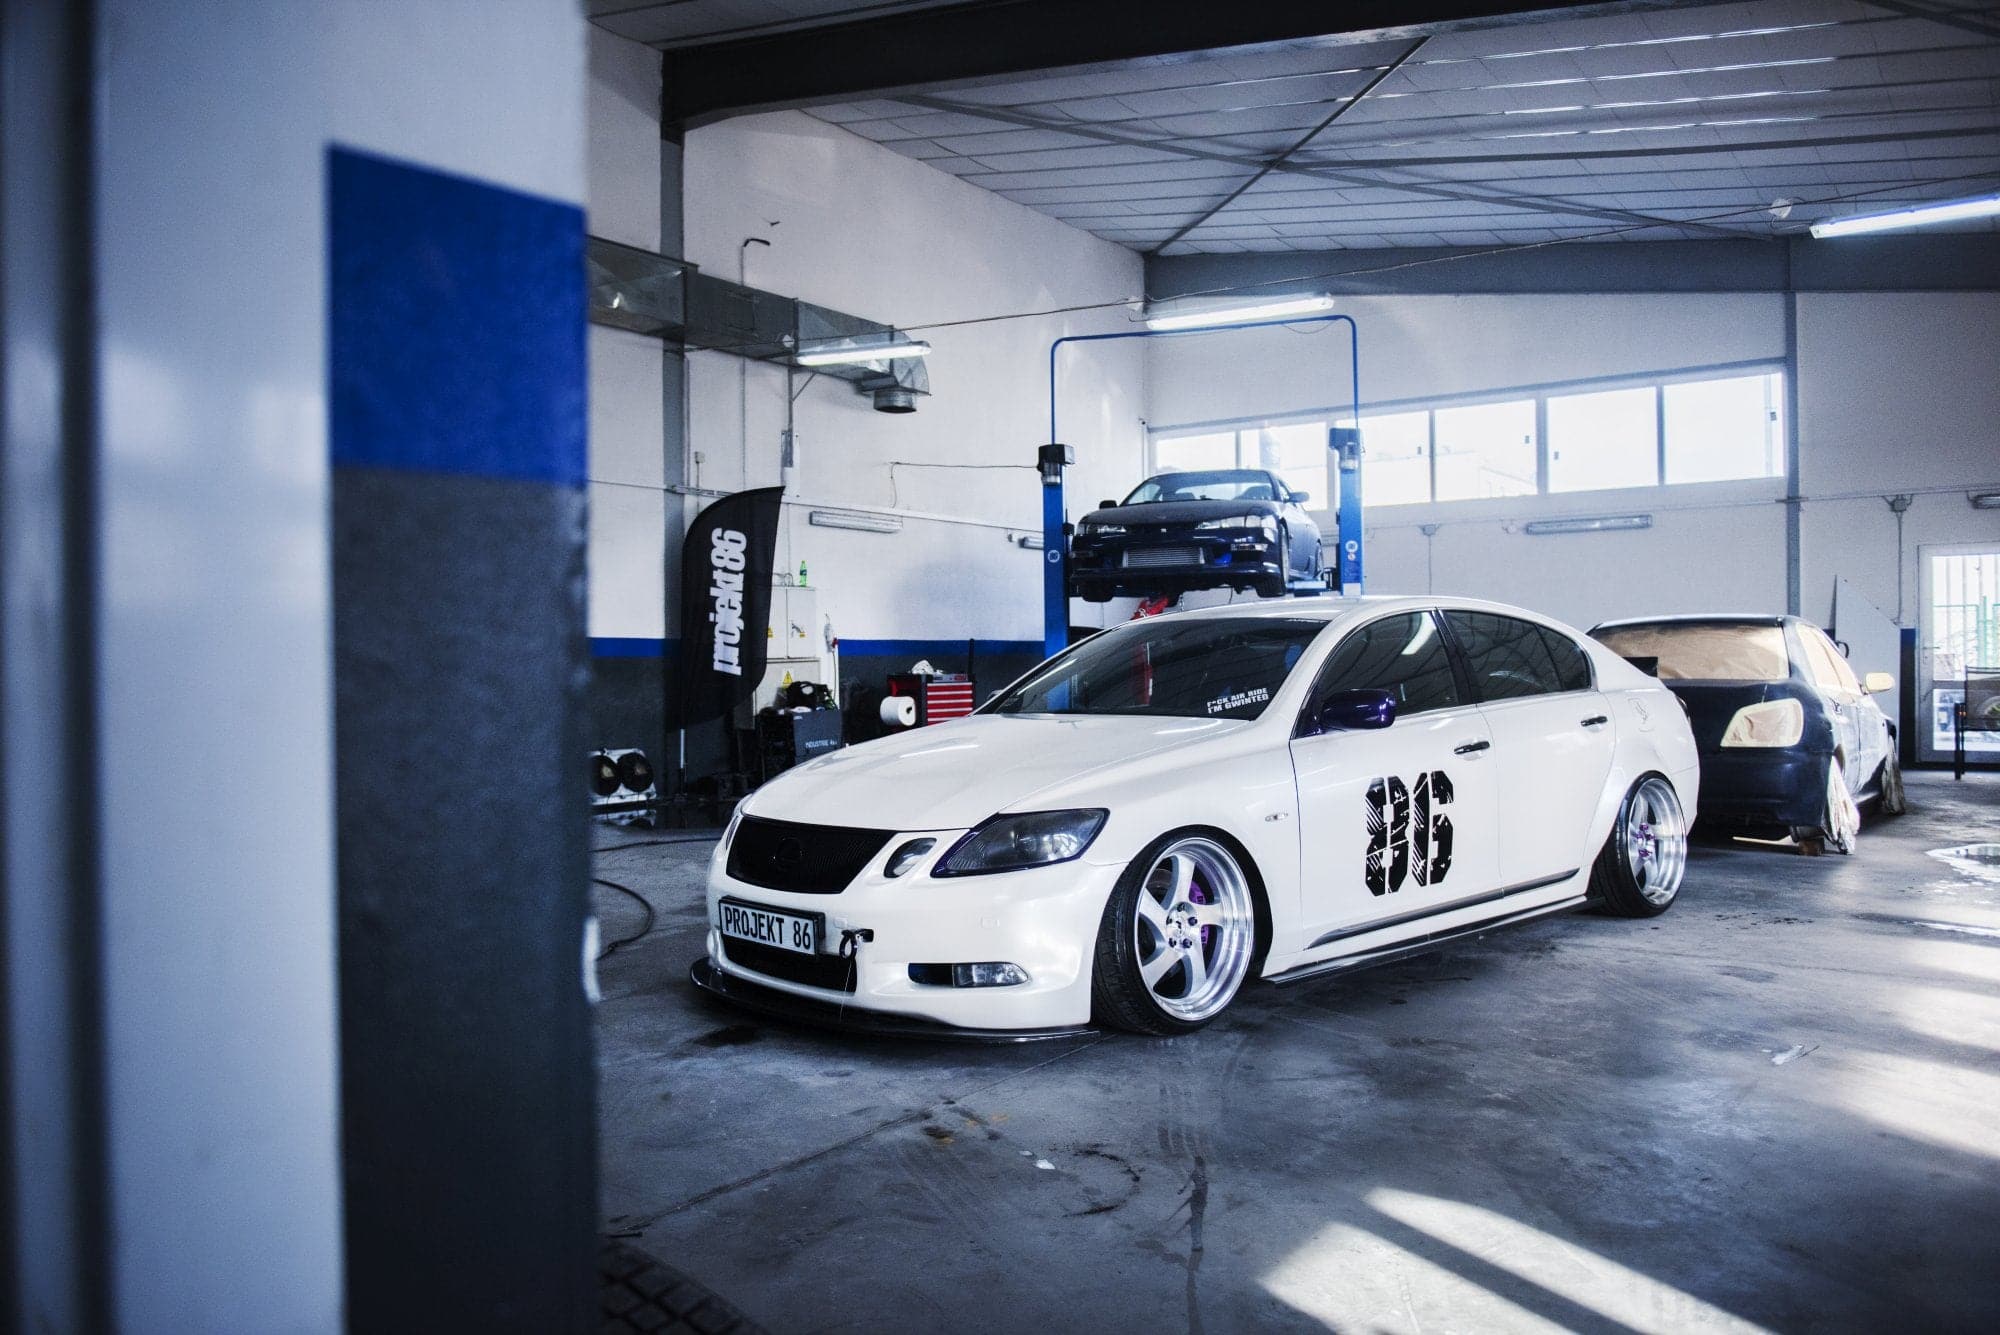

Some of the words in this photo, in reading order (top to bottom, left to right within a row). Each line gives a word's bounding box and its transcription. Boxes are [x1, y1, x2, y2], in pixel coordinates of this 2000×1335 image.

[709, 528, 747, 676] projekt86
[1208, 704, 1223, 714] I'M
[1224, 693, 1269, 709] GWINTED
[1231, 692, 1245, 701] AIR
[1247, 688, 1268, 697] RIDE
[1365, 770, 1454, 896] 86
[724, 906, 784, 944] PROJEKT
[793, 920, 811, 950] 86
